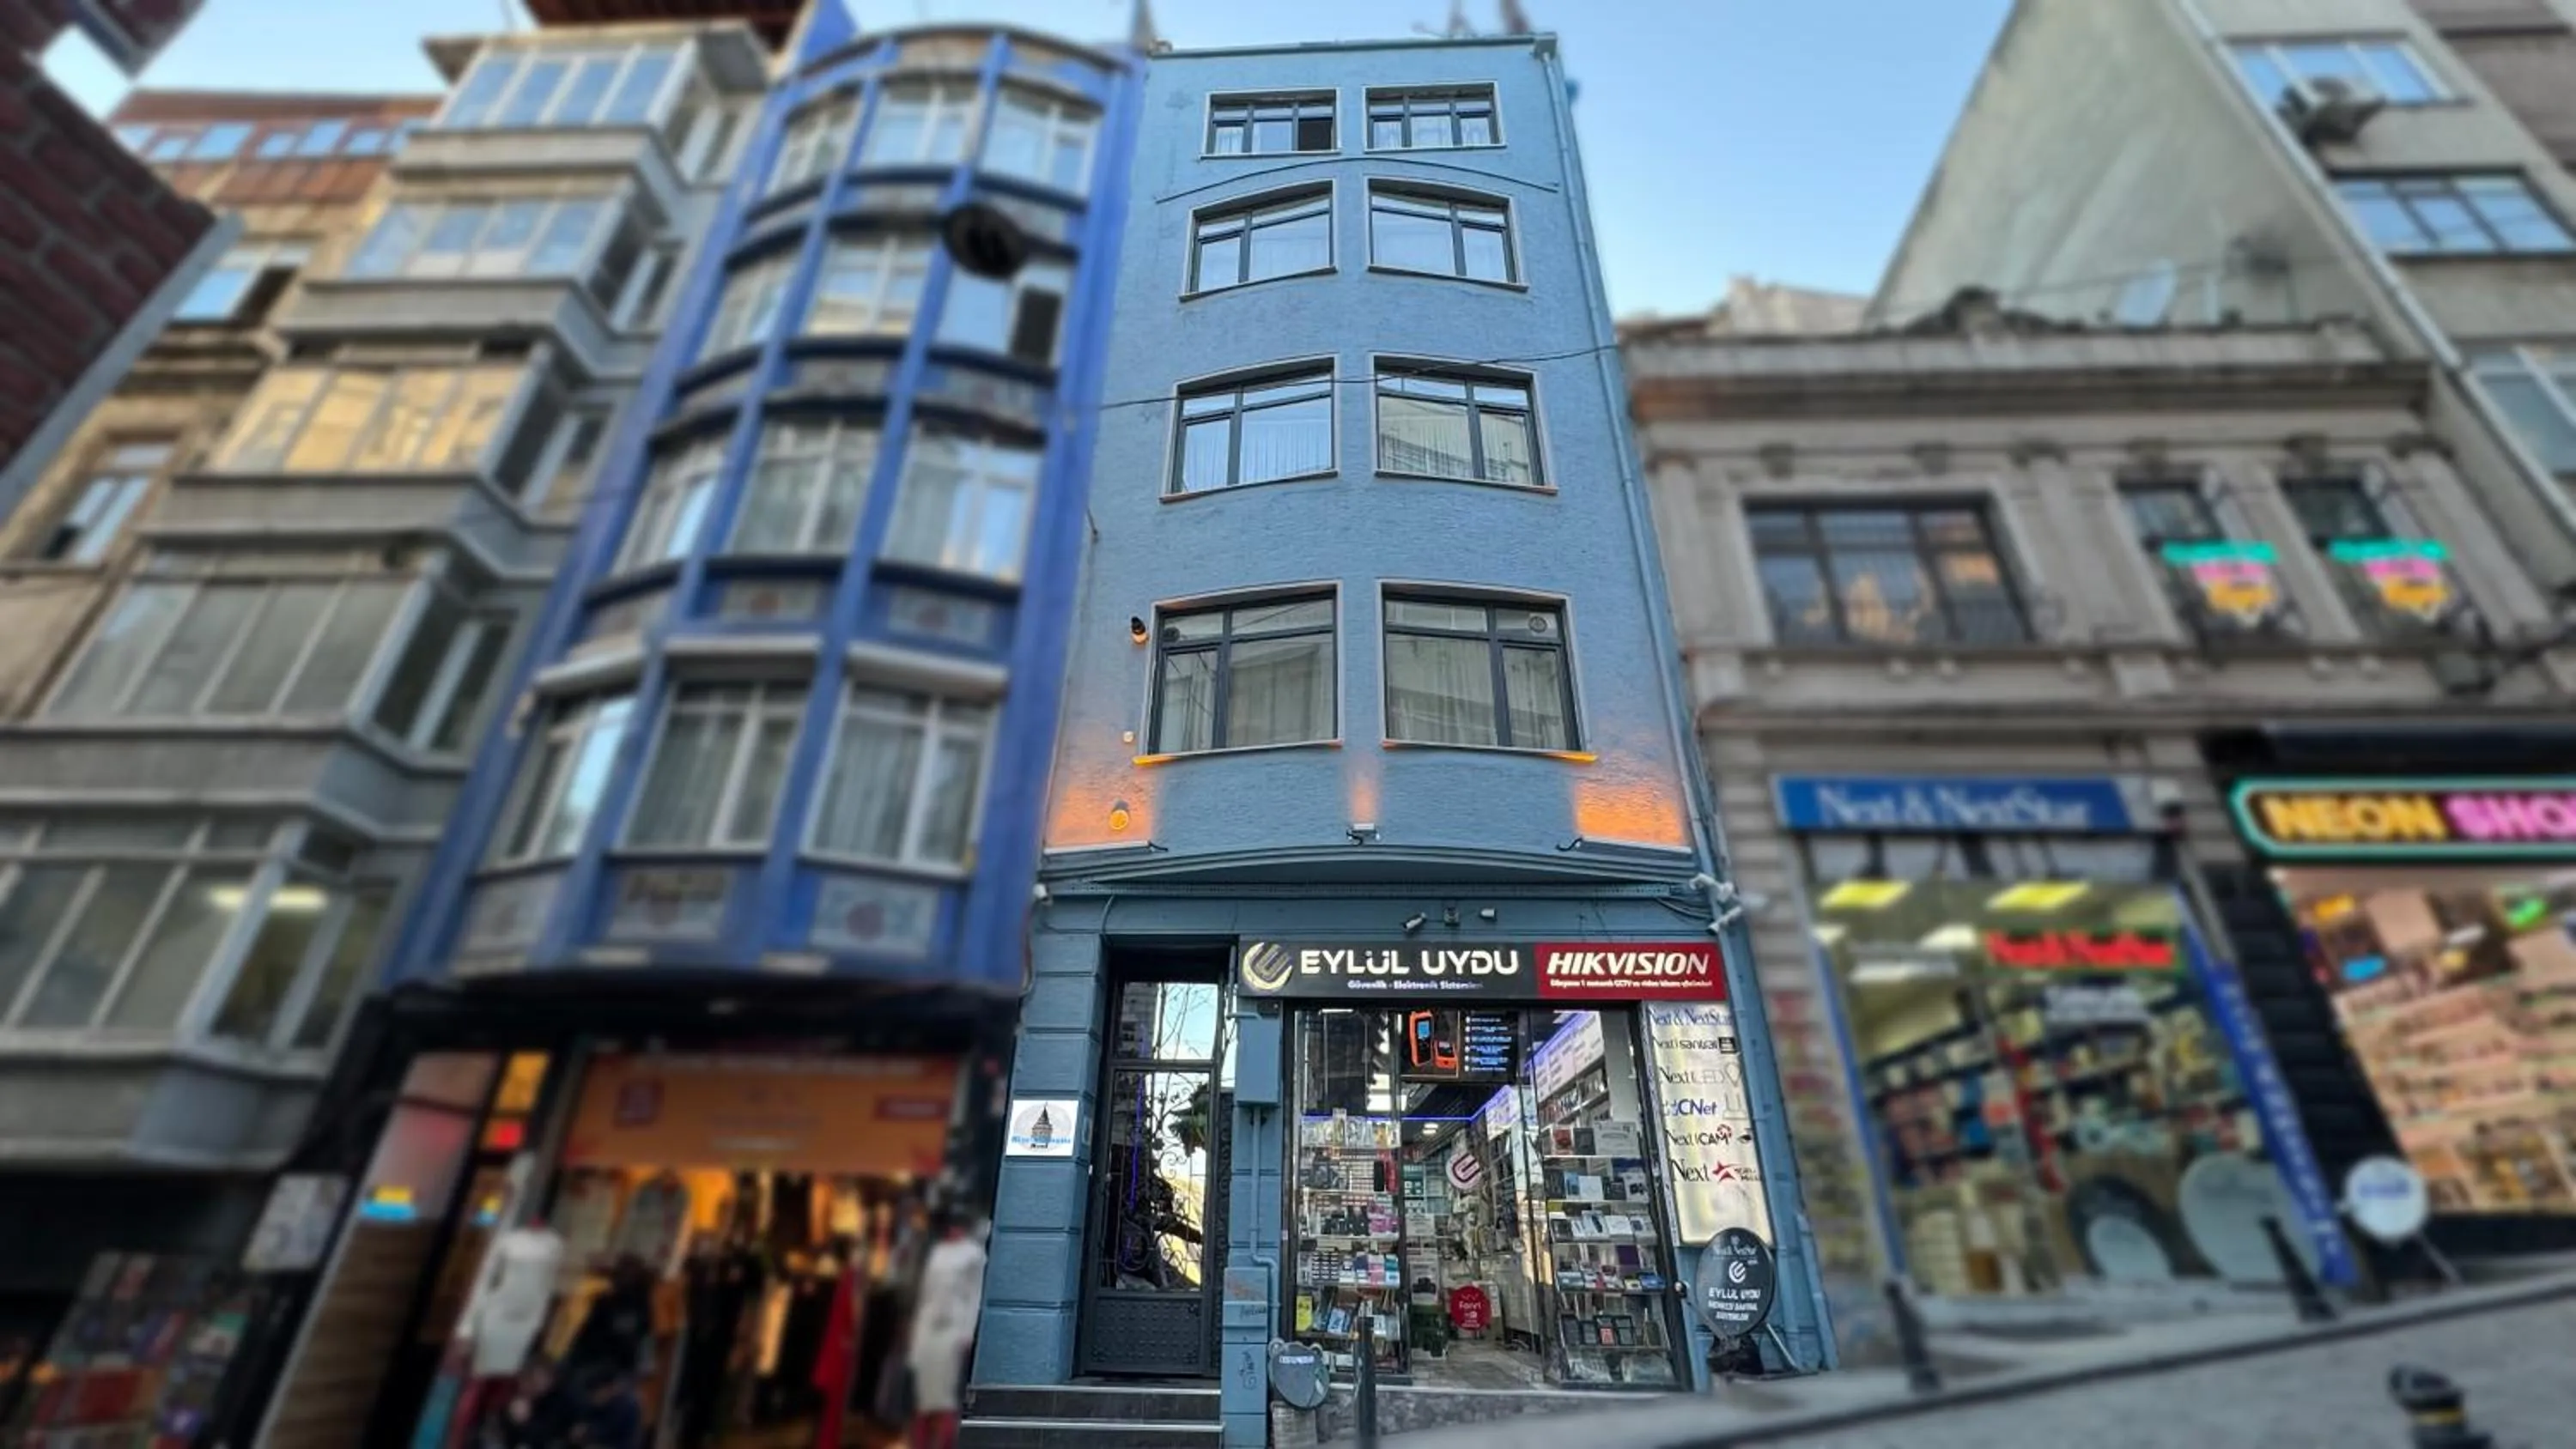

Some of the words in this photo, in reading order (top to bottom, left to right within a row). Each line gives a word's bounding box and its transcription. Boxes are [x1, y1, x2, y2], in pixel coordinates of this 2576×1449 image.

[2261, 794, 2447, 840] NEON
[1301, 950, 1410, 975] EYLÜL
[1421, 950, 1519, 975] UYDU
[1546, 952, 1709, 976] HIKVISION
